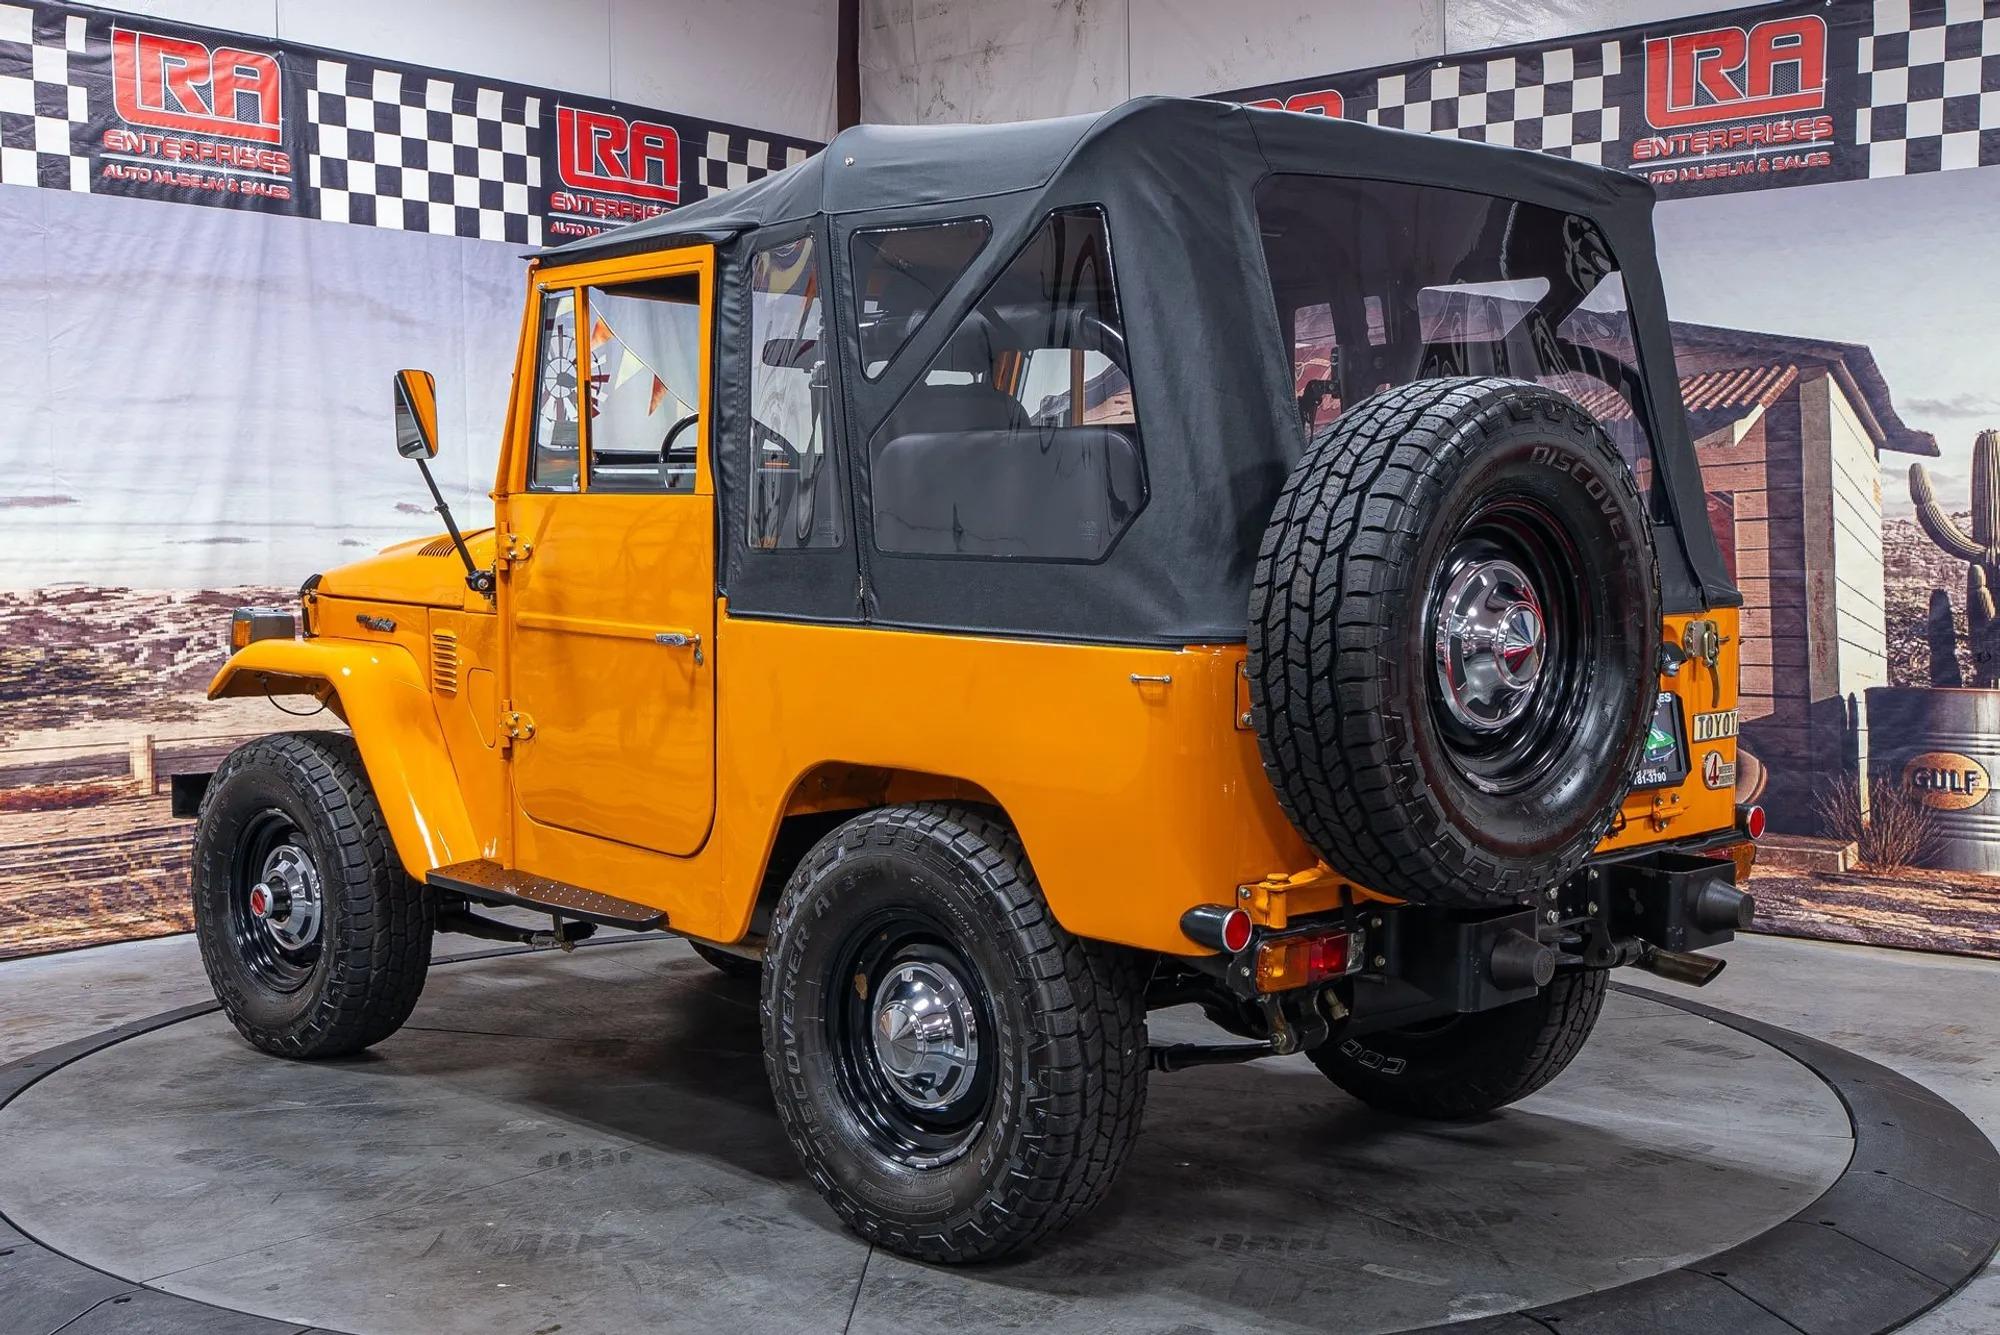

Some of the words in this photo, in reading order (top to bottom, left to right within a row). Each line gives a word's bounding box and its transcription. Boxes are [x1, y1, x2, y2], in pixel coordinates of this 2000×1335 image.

[102, 128, 292, 175] ENTERPRISES
[1632, 114, 1834, 161] ENTERPRISES
[103, 164, 152, 182] AUTO
[153, 170, 226, 192] MUSEUM
[227, 178, 239, 193] &
[240, 180, 291, 200] SALES
[1679, 161, 1754, 182] MUSEUM
[1758, 158, 1770, 173] &
[1772, 151, 1832, 171] SALES
[550, 191, 672, 223] ENTERPRIS
[550, 221, 586, 237] AUTO
[1708, 754, 1720, 786] 4
[1914, 767, 1981, 796] GULF
[1340, 1039, 1407, 1075] COO
